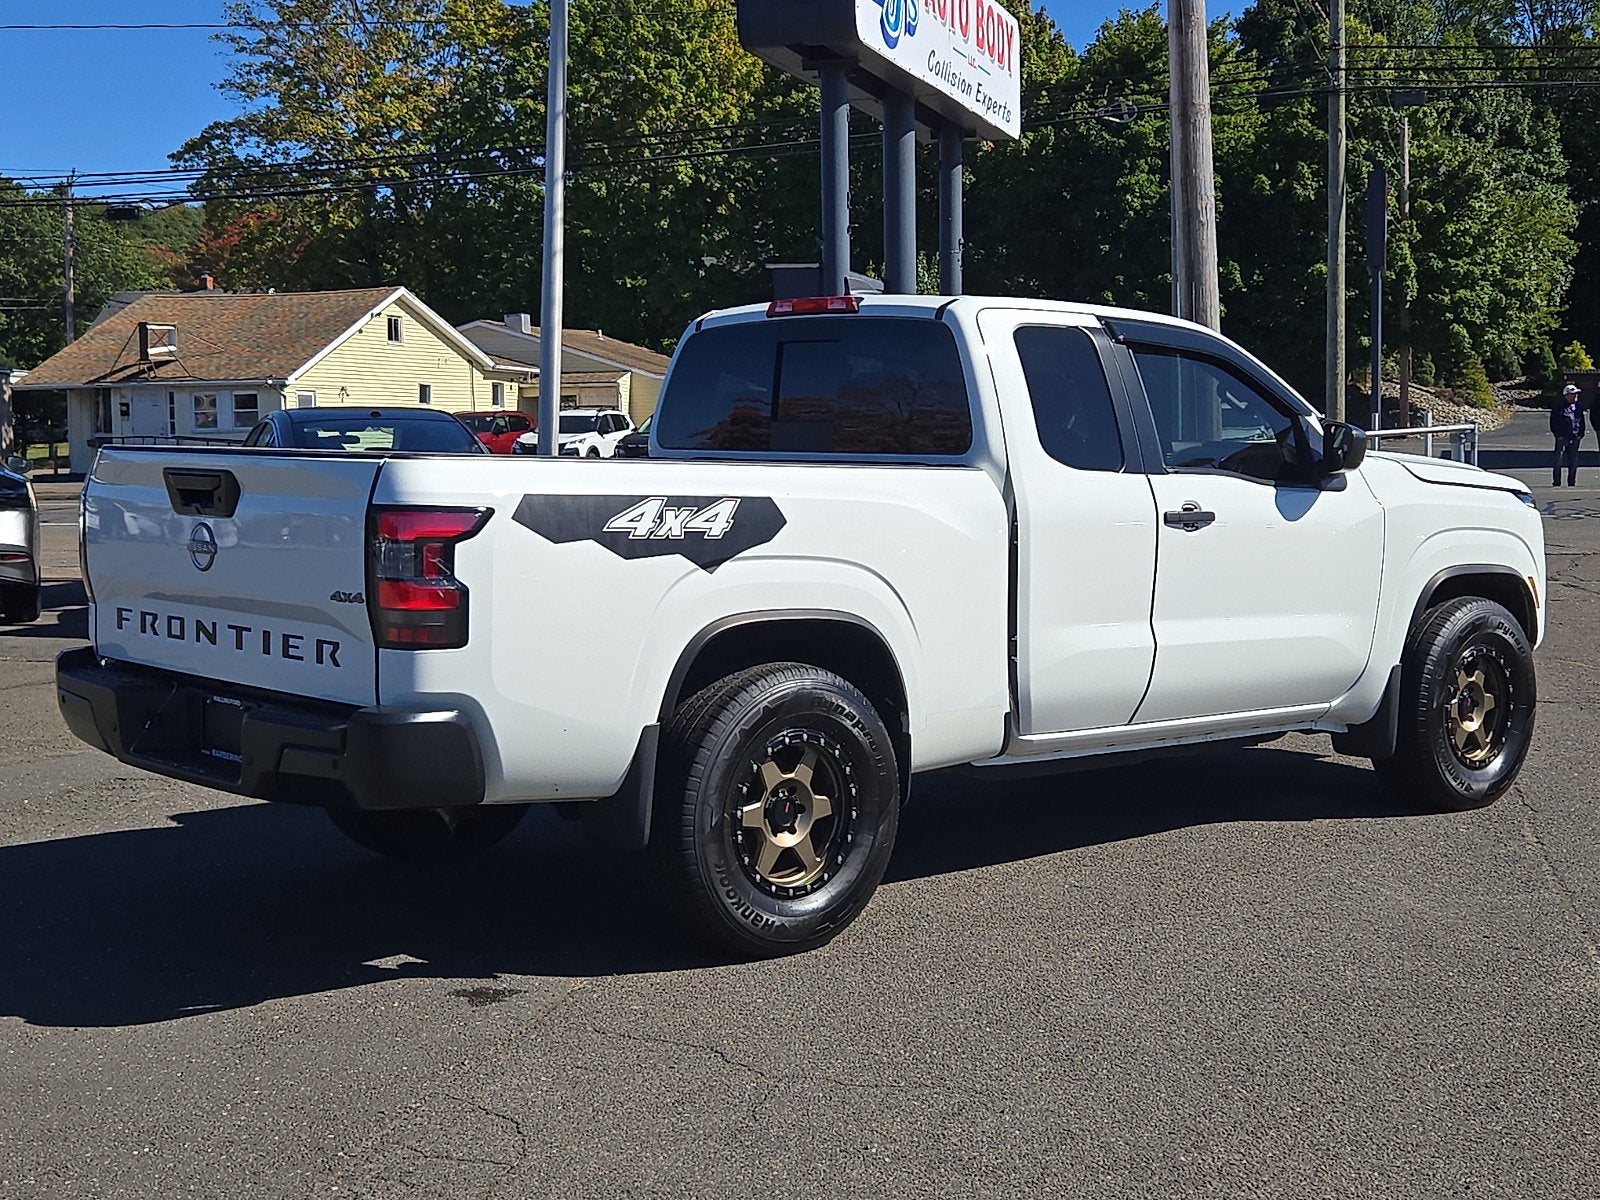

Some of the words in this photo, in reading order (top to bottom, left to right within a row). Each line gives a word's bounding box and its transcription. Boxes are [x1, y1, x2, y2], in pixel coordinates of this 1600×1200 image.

[924, 0, 970, 41] TO
[976, 0, 1014, 74] BODY
[928, 50, 972, 98] Collision
[976, 82, 1011, 123] Experts
[603, 497, 741, 539] 4x4
[116, 606, 342, 668] FRONTIER
[1496, 621, 1527, 657] Dynap
